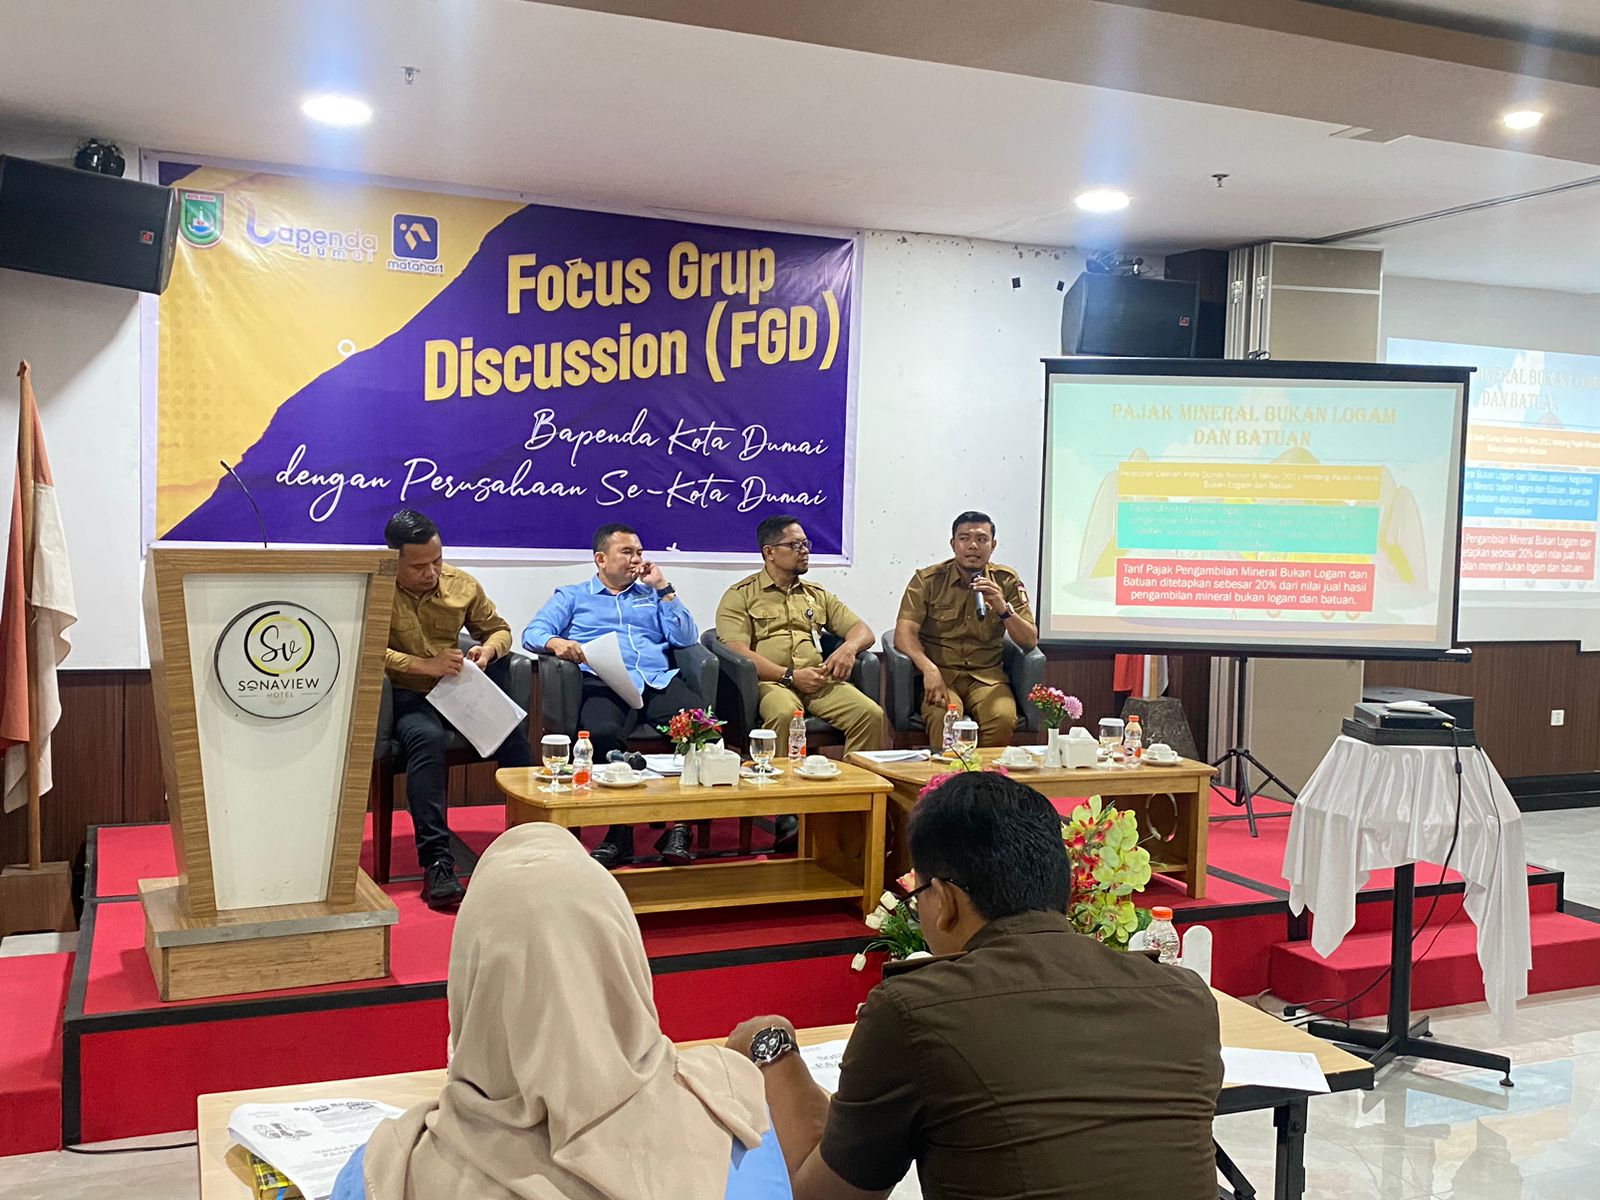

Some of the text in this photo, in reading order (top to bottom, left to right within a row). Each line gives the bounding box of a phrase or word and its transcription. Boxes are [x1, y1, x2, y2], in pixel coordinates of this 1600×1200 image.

[507, 241, 775, 315] Focus Grup
[424, 289, 840, 401] Discussion (FGD)
[1112, 402, 1397, 424] PAJAK MINERAL BUKAN LOGAM
[524, 408, 829, 467] Bapenda Kota Dumai
[1194, 428, 1311, 446] DAN BATUAN
[275, 443, 828, 522] dengan Perusahaan Se-Kota Dumai
[1123, 564, 1368, 580] Tarif Pajak Pengambilan Mineral Bukan Logam dan
[1123, 576, 1367, 593] Batuan ditetapkan sebesar 20% dari nilai jual hasil
[1131, 590, 1357, 605] pengambilan mineral bukan logam dan batuan.
[238, 678, 319, 692] SONAVIEW
